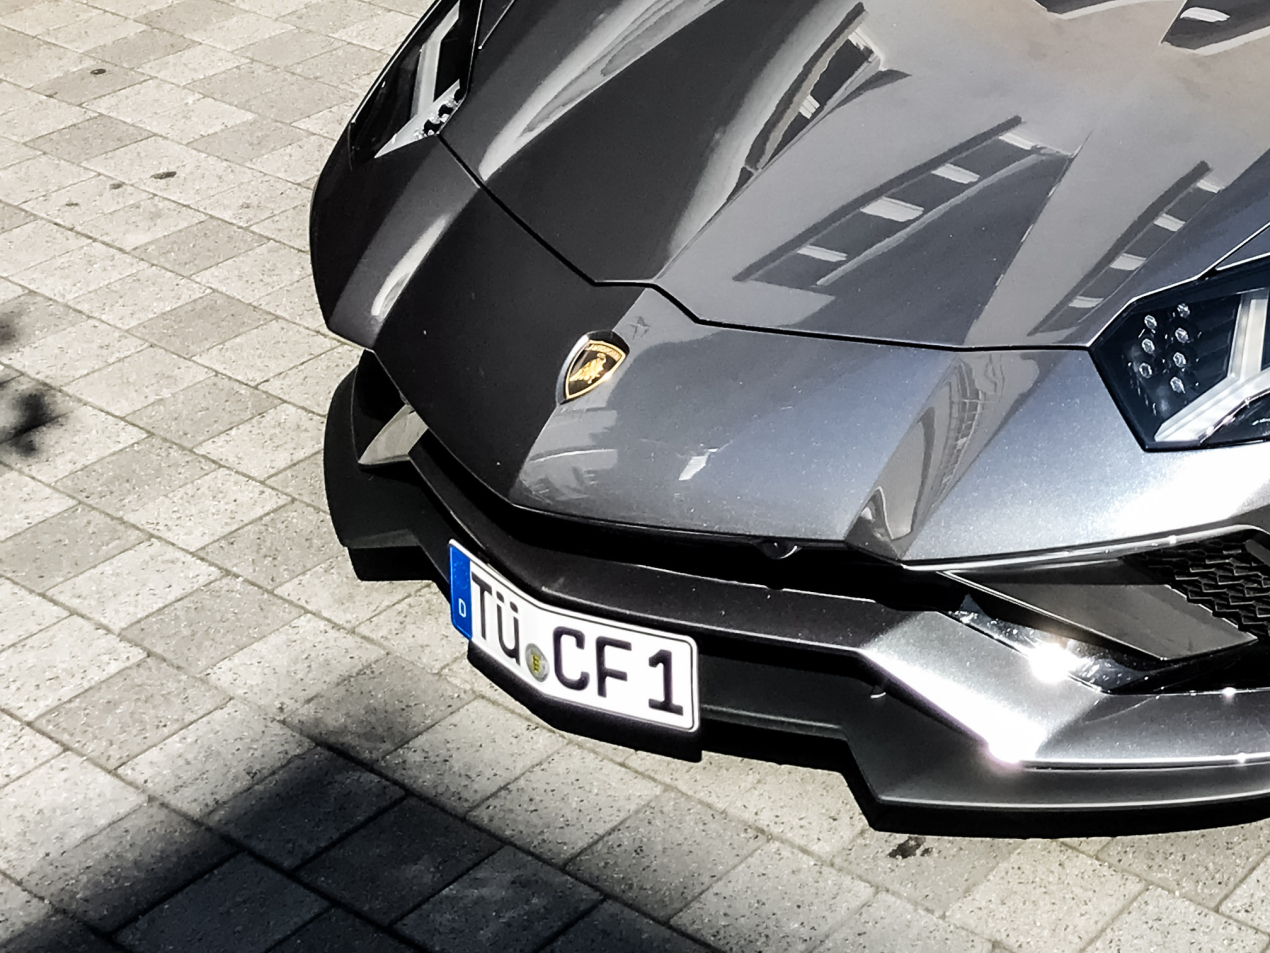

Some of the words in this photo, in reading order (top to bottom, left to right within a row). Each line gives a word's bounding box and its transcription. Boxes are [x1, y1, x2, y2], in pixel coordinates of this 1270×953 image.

[458, 598, 467, 618] D
[471, 570, 522, 666] TÜ
[552, 624, 633, 699] CF
[648, 649, 684, 716] 1
